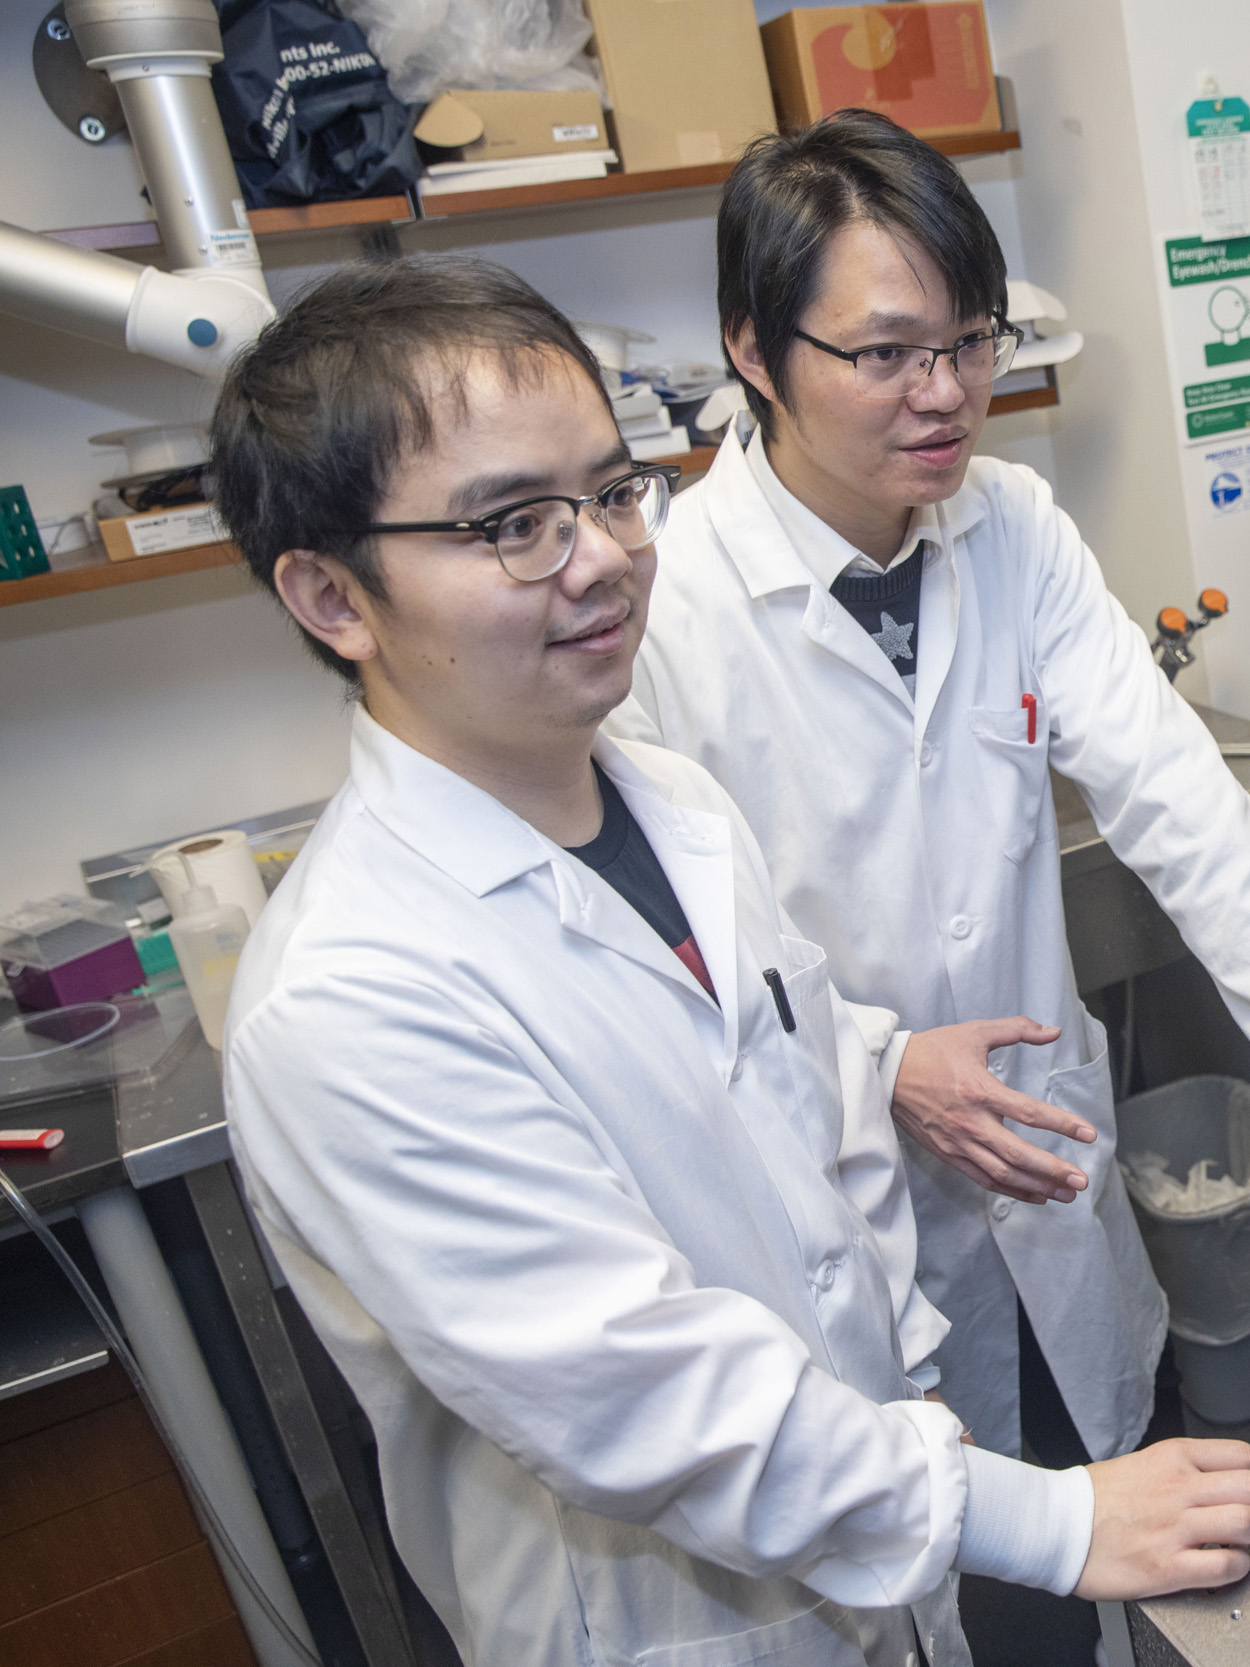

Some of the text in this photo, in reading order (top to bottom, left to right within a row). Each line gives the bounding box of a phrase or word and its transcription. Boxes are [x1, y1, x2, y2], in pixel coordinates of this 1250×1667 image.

[309, 41, 341, 58] Inc.
[1170, 245, 1227, 263] Emergency
[1205, 446, 1243, 461] PROTECT
